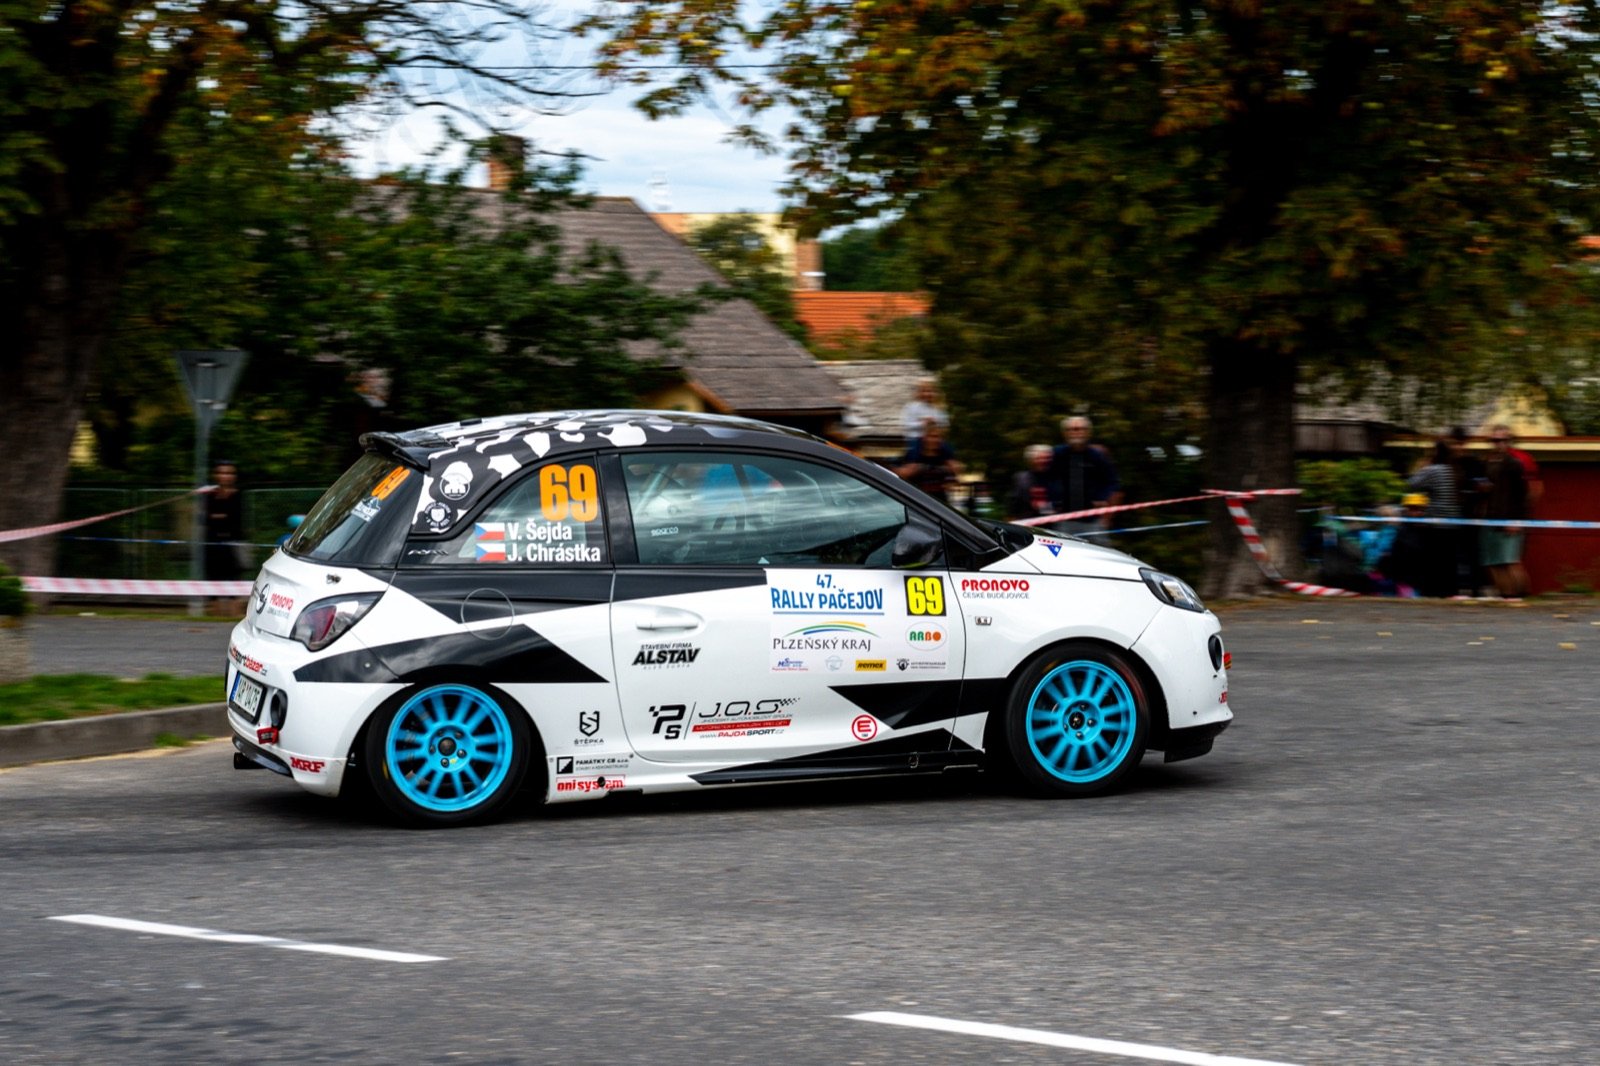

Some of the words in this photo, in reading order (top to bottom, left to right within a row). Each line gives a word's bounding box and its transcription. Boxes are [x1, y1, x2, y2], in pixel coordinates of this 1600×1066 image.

[539, 464, 598, 522] 69
[507, 522, 523, 541] V.
[526, 518, 573, 544] Šejda
[507, 543, 523, 562] J.
[526, 543, 601, 562] Chrástka
[816, 574, 837, 589] 47.
[961, 579, 1030, 592] PRONOVO
[771, 587, 815, 609] RALLY
[819, 588, 883, 610] PAČEJOV
[906, 576, 944, 615] 69
[773, 636, 839, 650] PLZEŇSKÝ
[842, 638, 871, 652] KRAJ
[909, 631, 942, 642] ARBO
[631, 647, 701, 666] ALSTAV
[857, 720, 871, 732] E
[289, 757, 325, 773] MRF
[557, 779, 624, 793] onisysem
